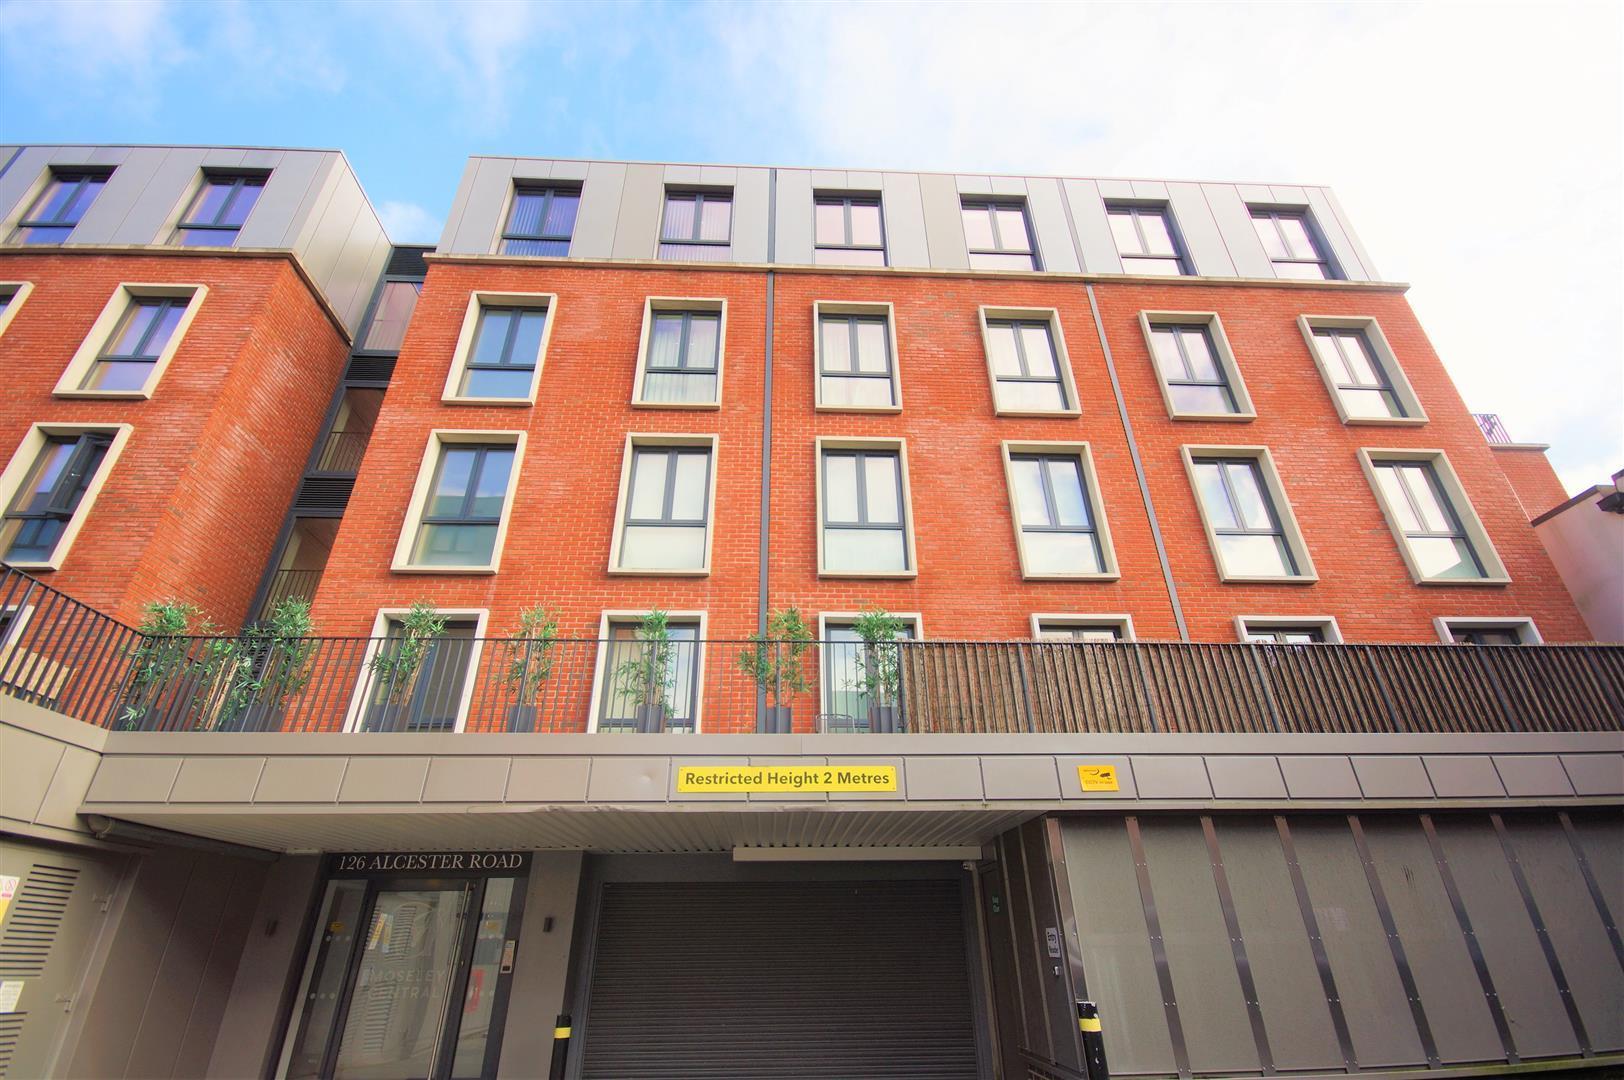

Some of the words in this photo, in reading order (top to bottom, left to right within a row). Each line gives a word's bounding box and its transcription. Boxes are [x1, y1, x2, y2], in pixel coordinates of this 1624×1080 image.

[685, 772, 763, 785] Restricted
[767, 772, 819, 788] Height
[823, 772, 833, 784] 2
[837, 771, 890, 784] Metres
[339, 855, 366, 870] 126
[369, 854, 464, 870] ALCESTER
[468, 853, 523, 869] ROAD
